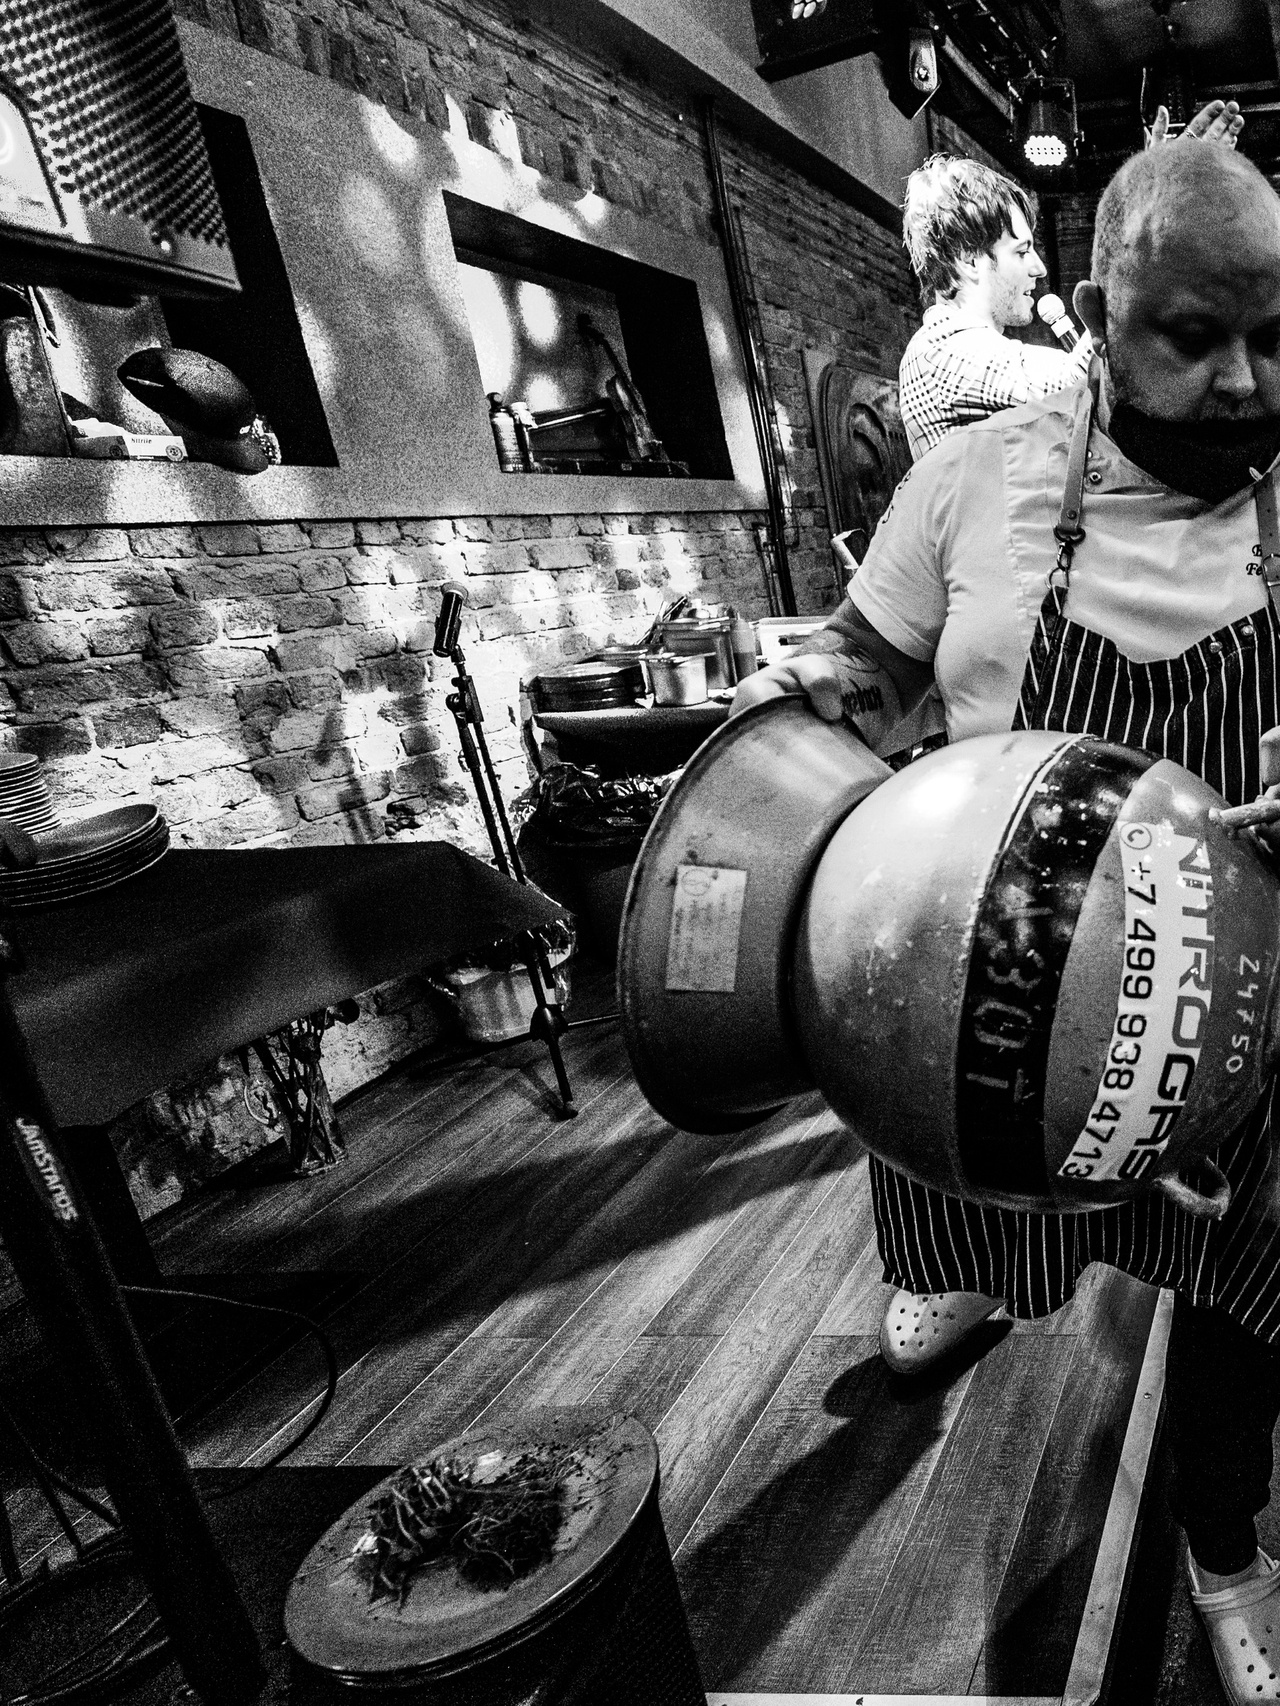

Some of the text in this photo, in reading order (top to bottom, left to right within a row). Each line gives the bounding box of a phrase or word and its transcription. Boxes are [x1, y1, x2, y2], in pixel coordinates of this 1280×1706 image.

[1122, 918, 1156, 1000] 499
[1116, 837, 1215, 1180] NITROGAS
[1102, 1013, 1148, 1091] 938
